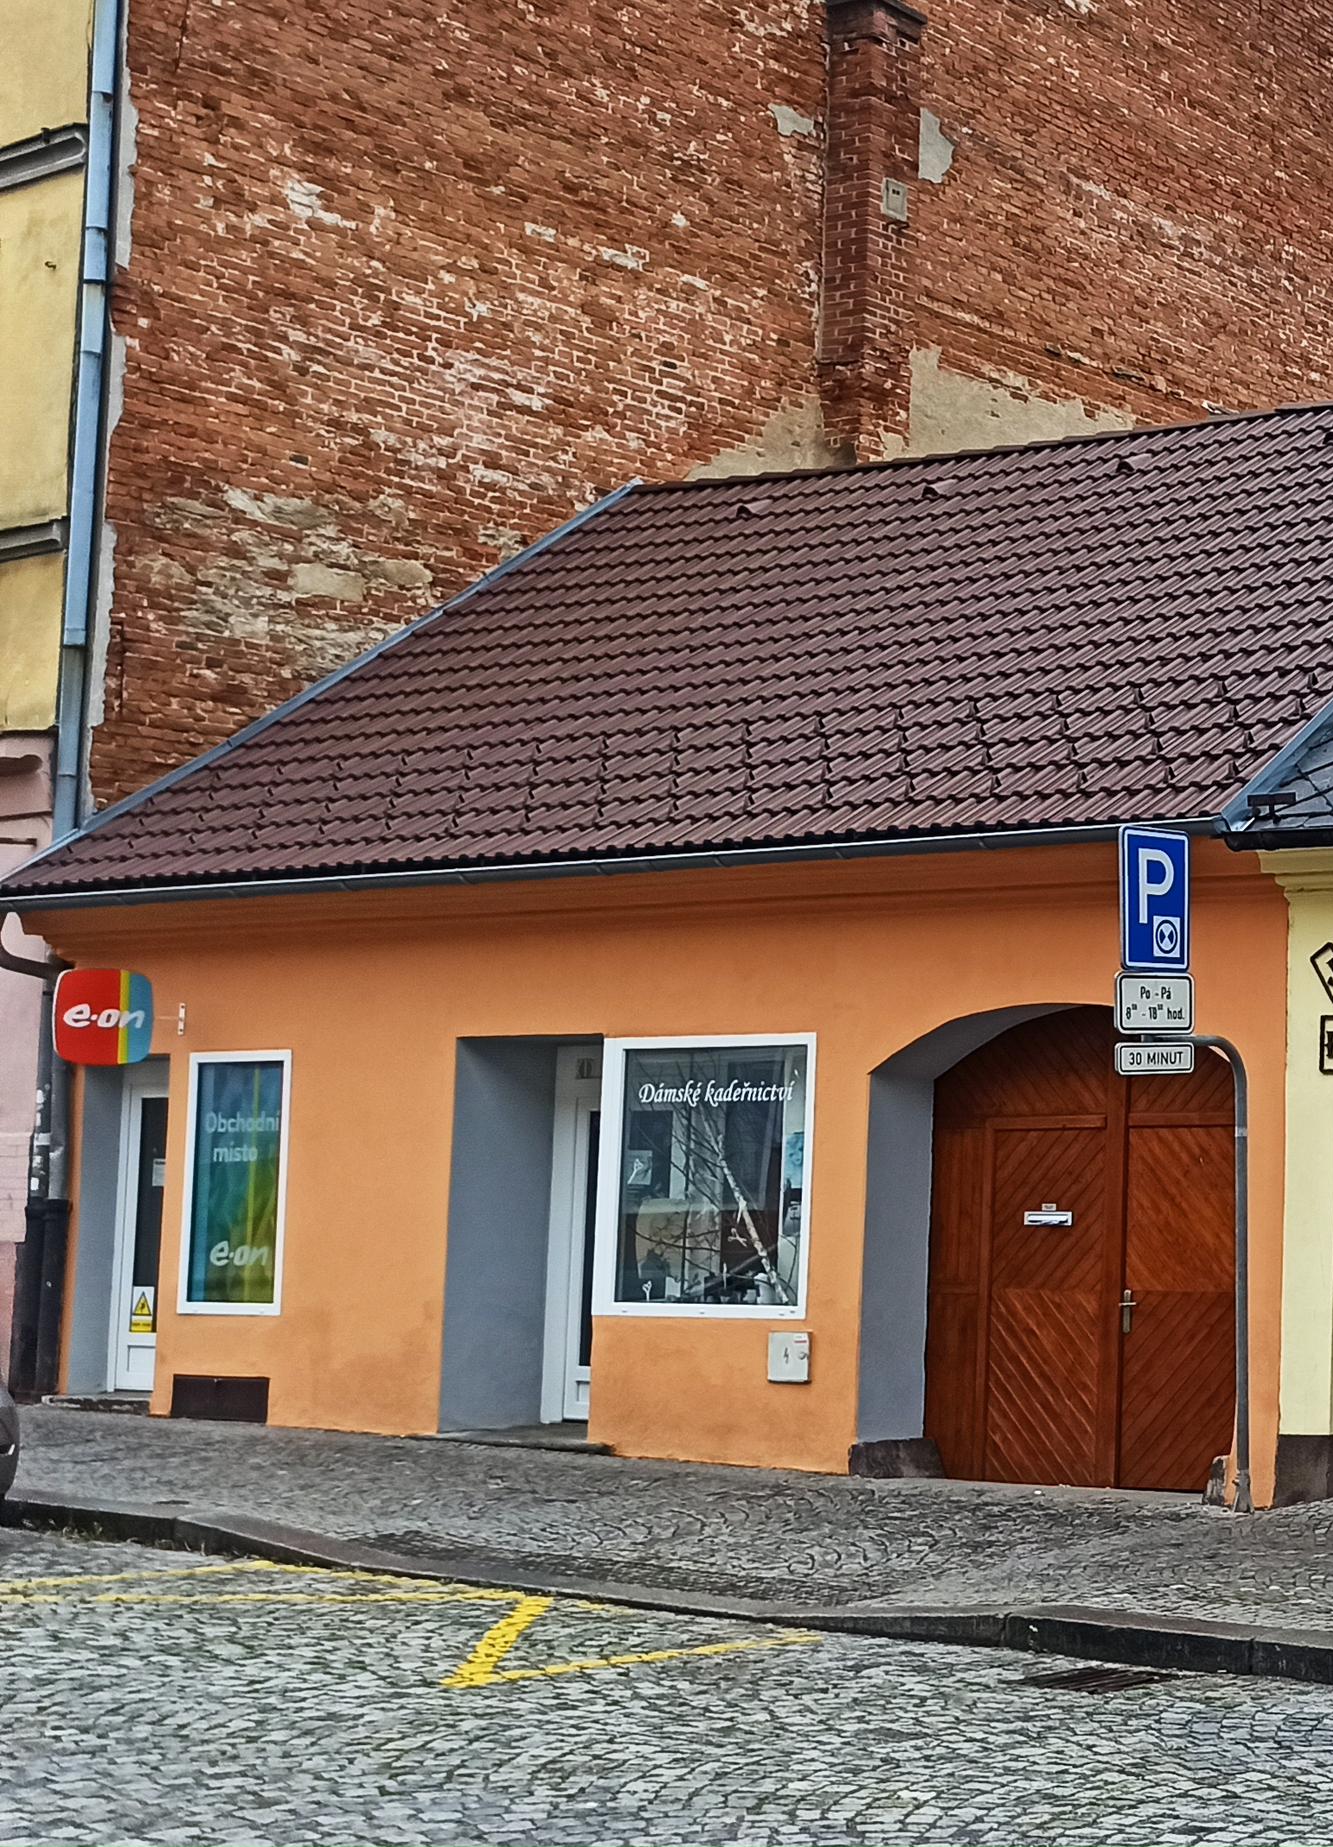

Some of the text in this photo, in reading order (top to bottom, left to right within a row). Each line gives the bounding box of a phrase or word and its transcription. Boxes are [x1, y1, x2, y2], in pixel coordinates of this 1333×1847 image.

[1138, 847, 1175, 924] P
[1140, 986, 1150, 999] Po
[1161, 986, 1171, 1000] Pá
[1167, 1007, 1185, 1020] hod.
[1129, 1051, 1183, 1065] 30 MINUT
[638, 1079, 795, 1107] Dámské kadeřnictví
[205, 1111, 281, 1133] Obchodní
[212, 1141, 257, 1163] místo
